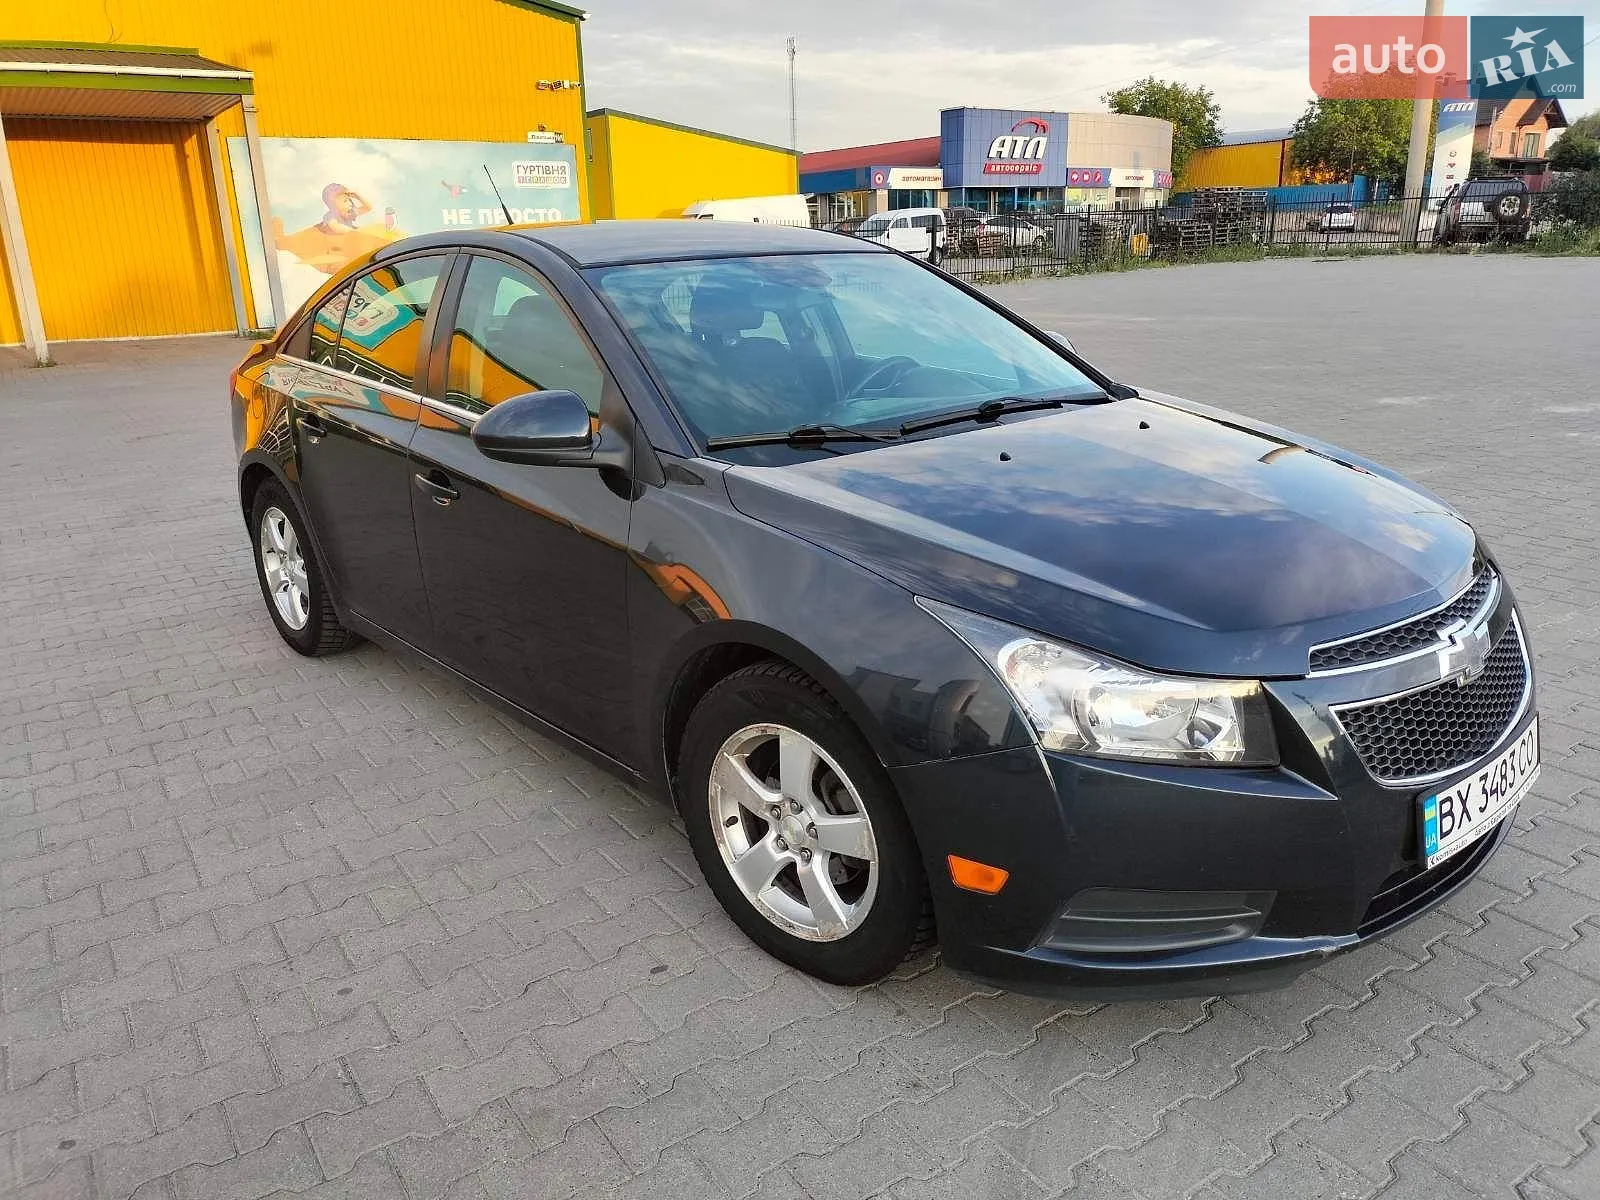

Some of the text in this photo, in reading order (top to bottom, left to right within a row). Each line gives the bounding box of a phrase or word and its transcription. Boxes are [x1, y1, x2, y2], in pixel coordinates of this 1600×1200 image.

[988, 135, 1048, 159] АТЛ
[516, 164, 567, 176] ГУРТІВНЯ
[991, 163, 1038, 173] автосервіс
[442, 207, 561, 225] НЕ ПРОСТО
[1439, 783, 1472, 840] BX
[1479, 750, 1516, 814] 3483
[1518, 729, 1534, 776] CO
[1425, 833, 1437, 849] UA
